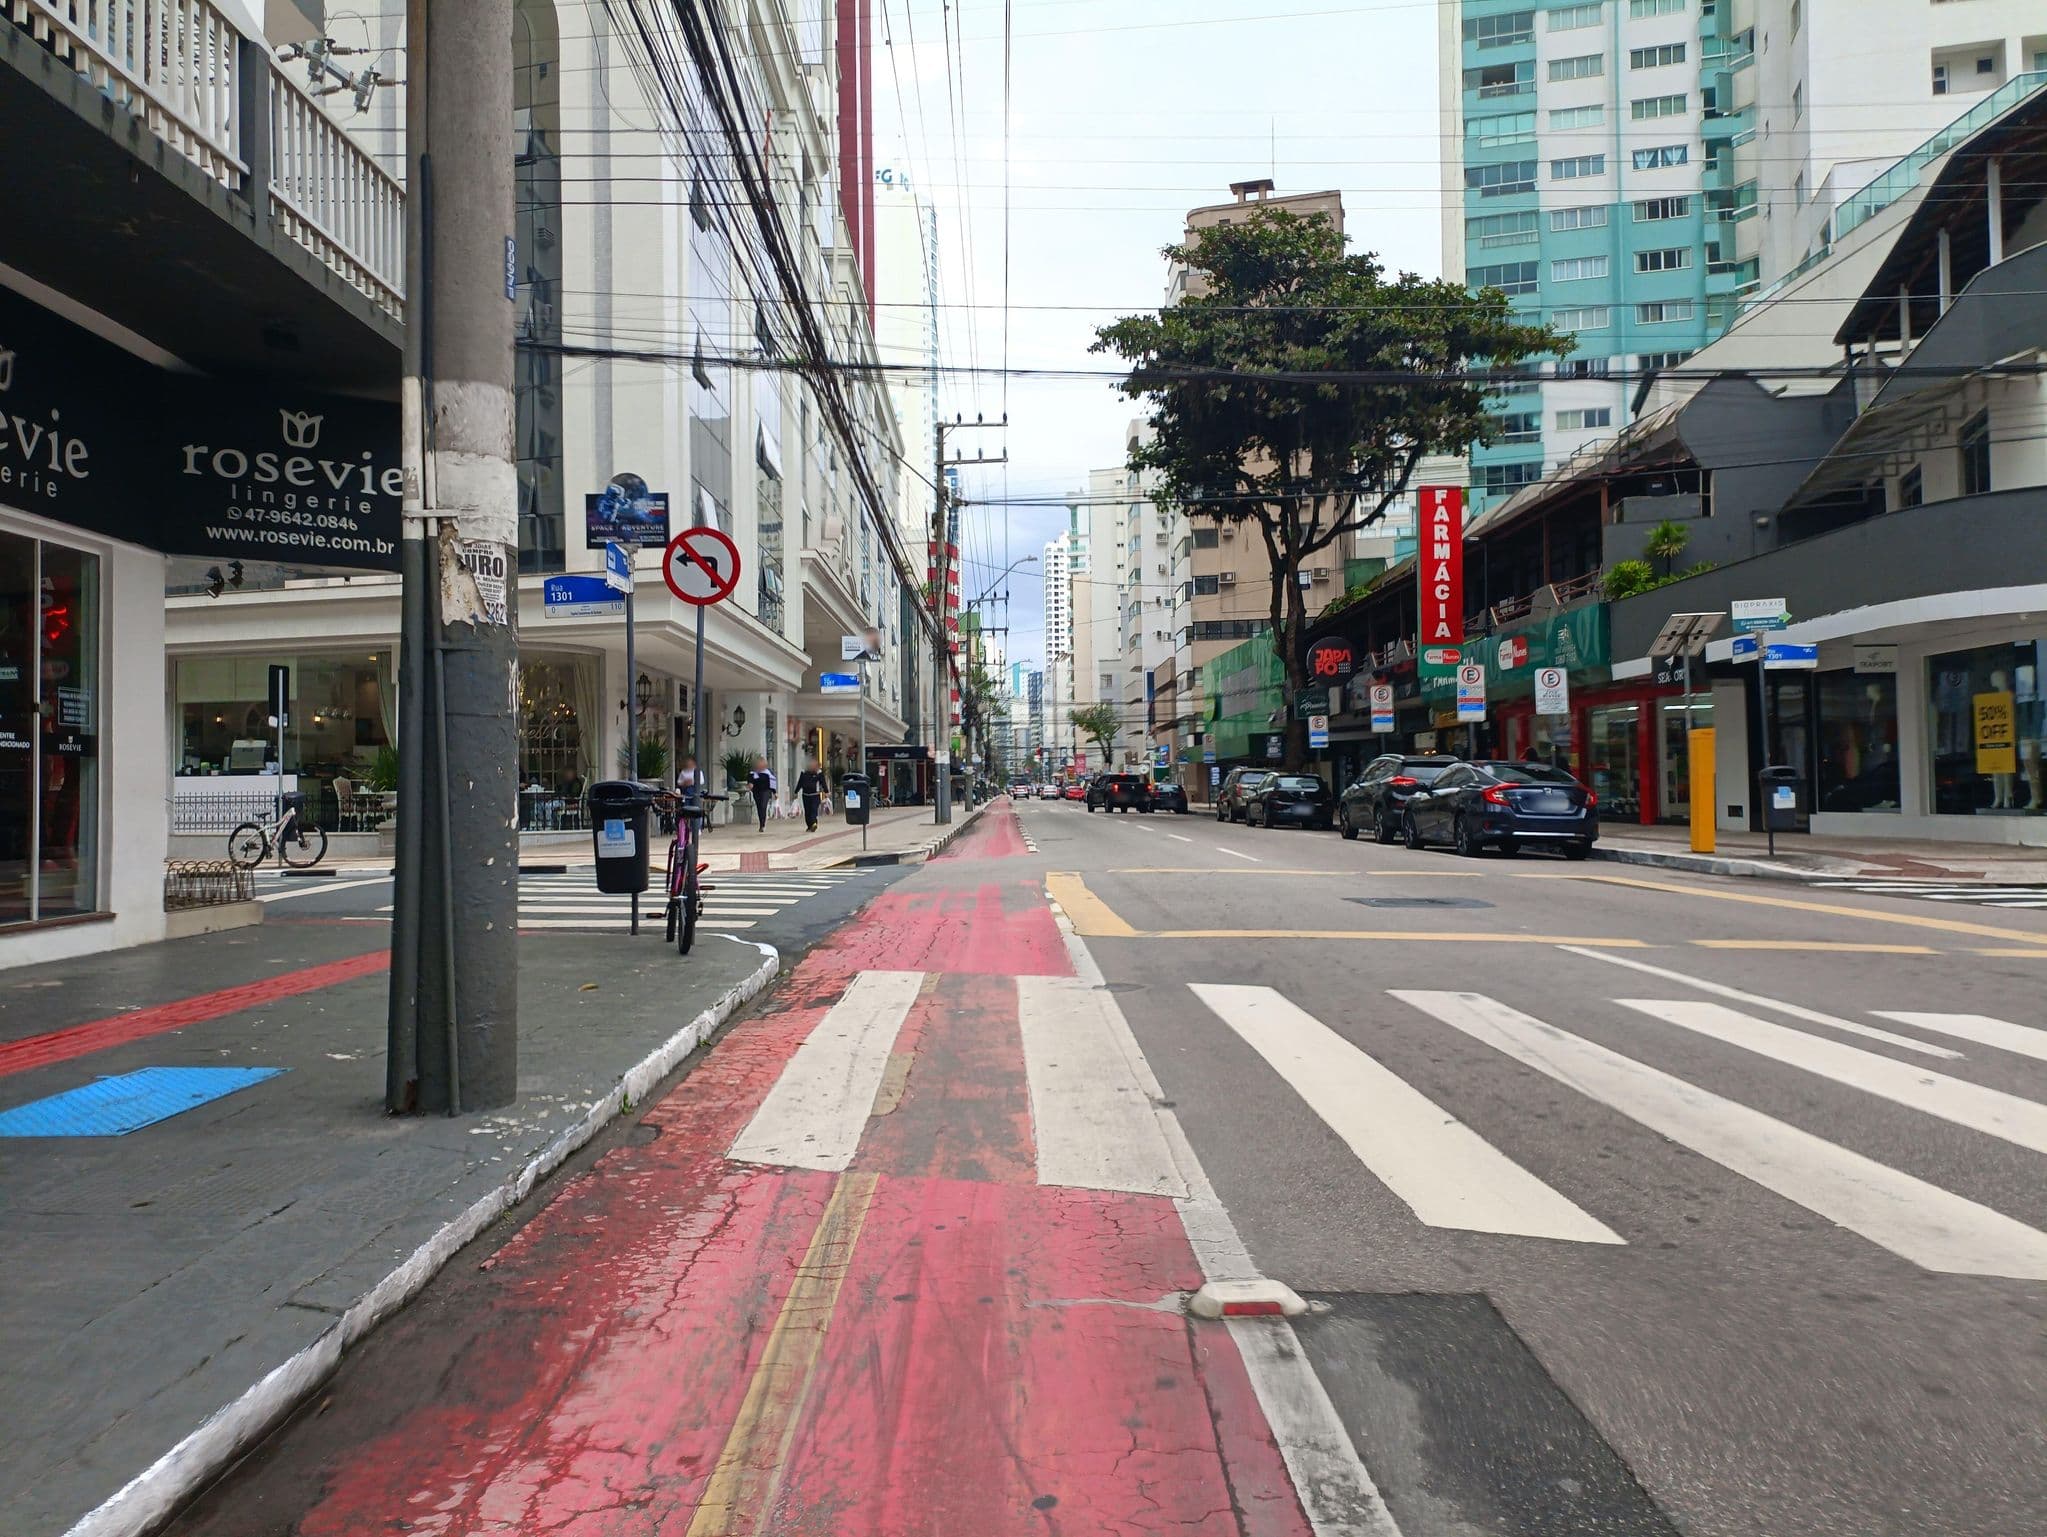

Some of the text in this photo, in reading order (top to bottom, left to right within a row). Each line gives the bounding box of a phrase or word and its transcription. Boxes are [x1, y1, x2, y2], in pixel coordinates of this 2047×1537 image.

[182, 444, 403, 497] rosevie
[231, 483, 372, 515] lingerie
[206, 525, 395, 554] www.rosevie.com.br
[463, 554, 504, 578] URO
[1434, 489, 1451, 638] FARMÁCIA
[551, 591, 573, 602] 1301
[1980, 723, 2008, 739] OFF
